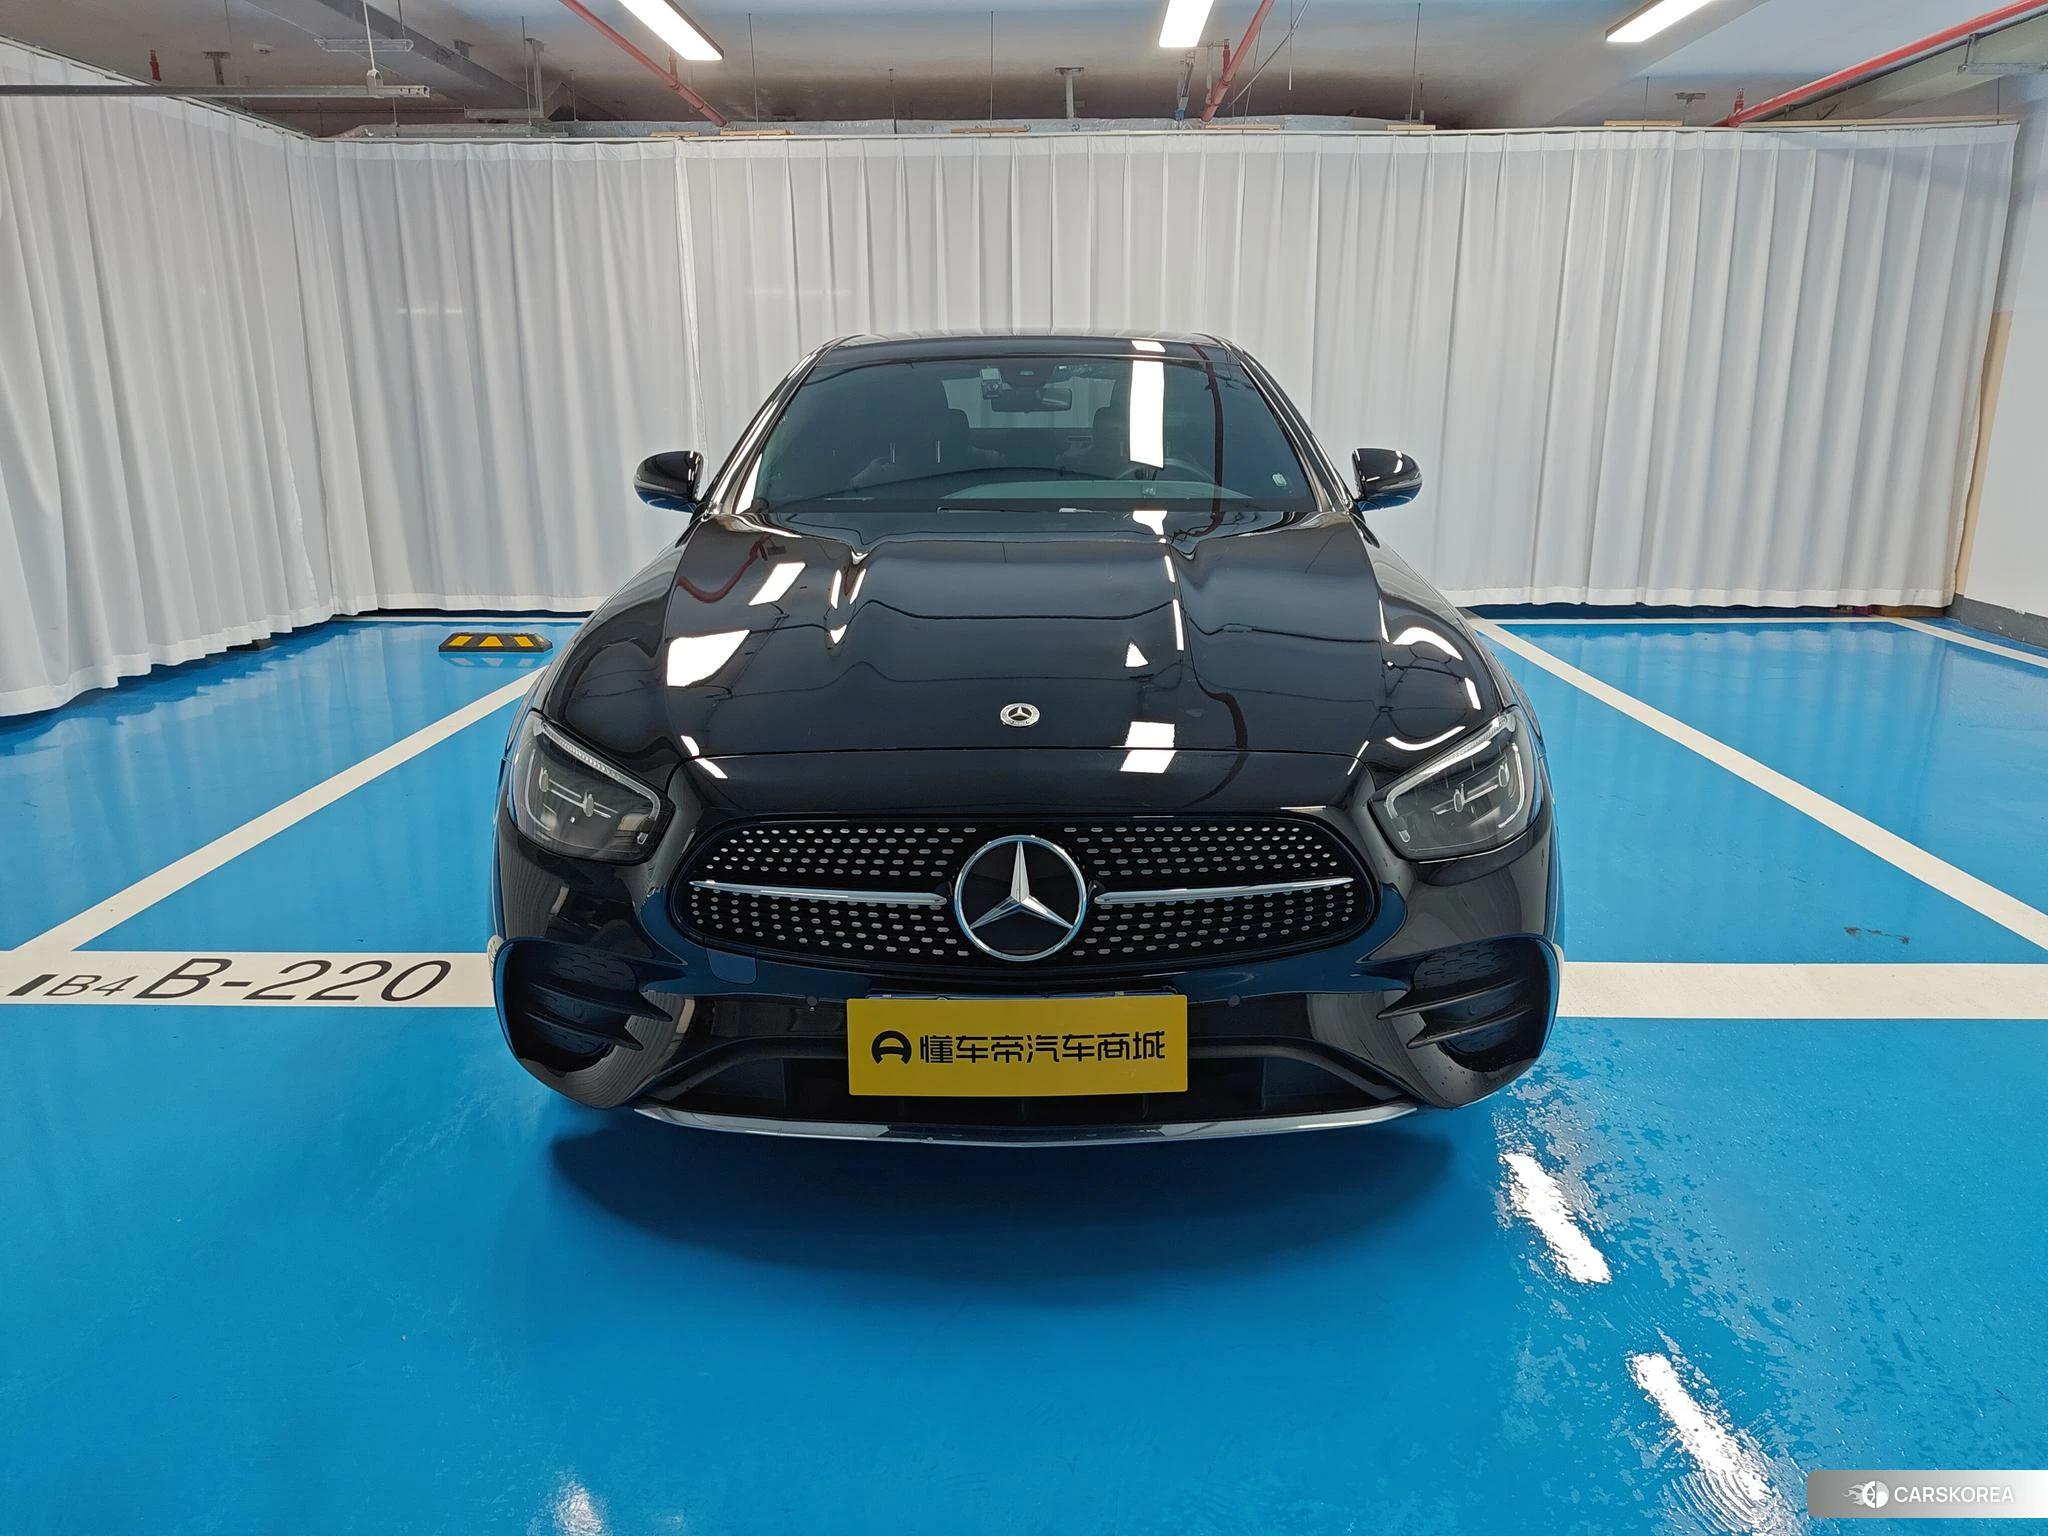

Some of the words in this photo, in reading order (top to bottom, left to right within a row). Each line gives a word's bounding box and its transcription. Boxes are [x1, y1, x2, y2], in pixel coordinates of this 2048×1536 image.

[133, 958, 452, 1002] B-220
[919, 1030, 1166, 1064] 懂车帝汽车商城
